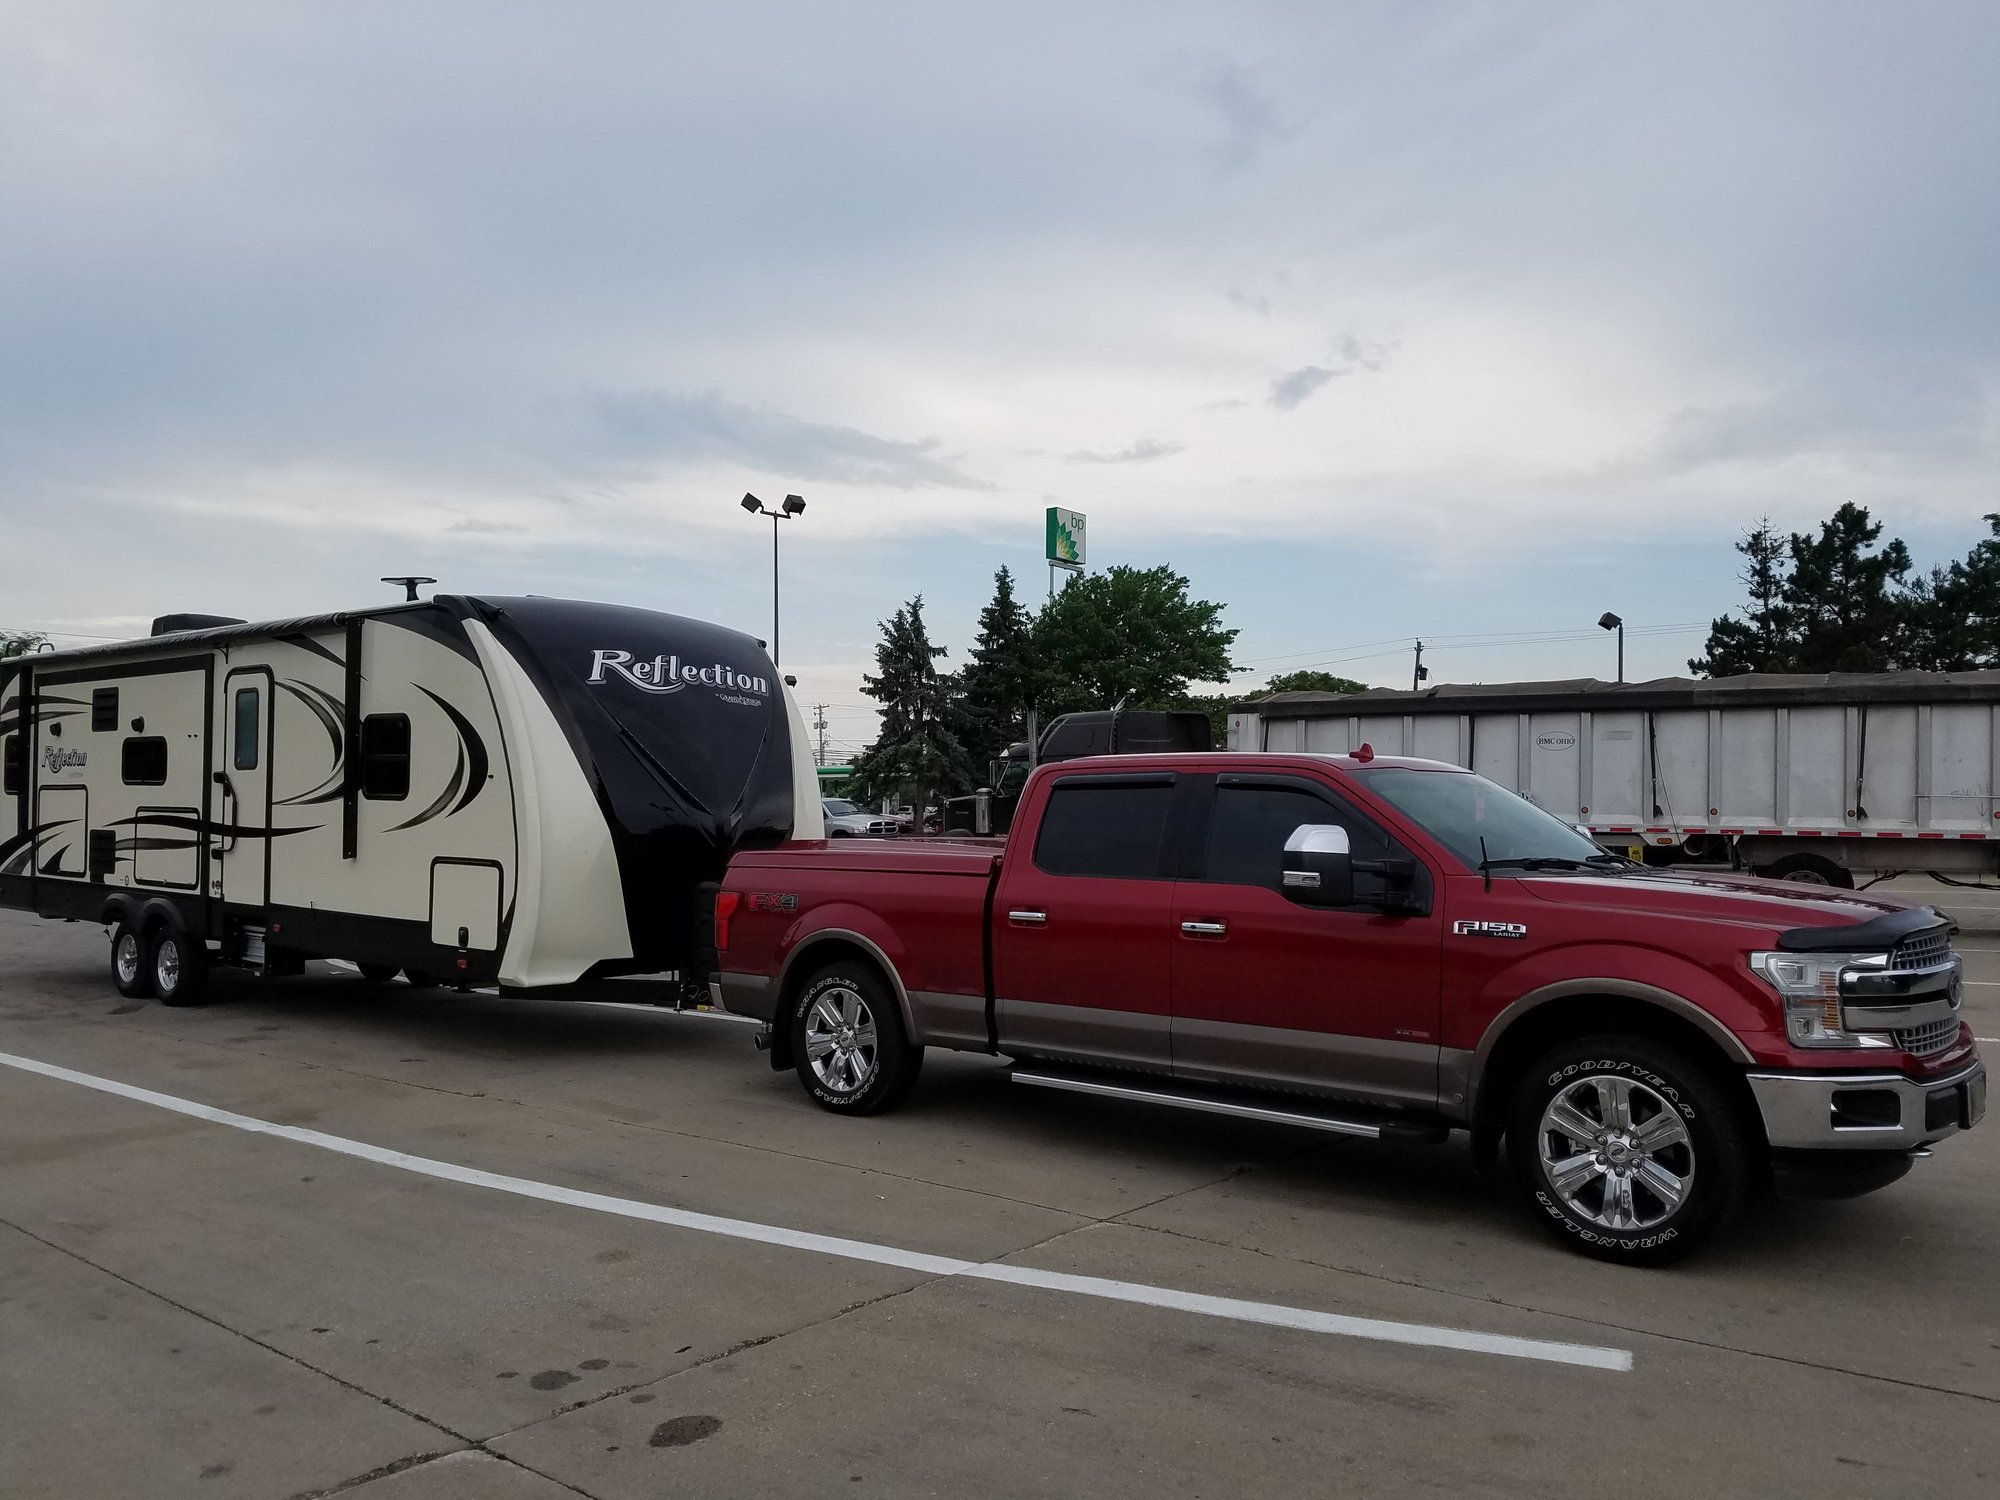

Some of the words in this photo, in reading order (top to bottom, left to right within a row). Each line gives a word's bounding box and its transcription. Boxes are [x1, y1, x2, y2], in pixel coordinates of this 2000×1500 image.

[1071, 513, 1084, 533] bp
[587, 649, 770, 697] Reflection
[41, 745, 88, 774] Reflection
[749, 891, 799, 913] FX4
[1548, 1060, 1695, 1119] GOODYEAR
[1536, 1191, 1678, 1249] WRANGLER
